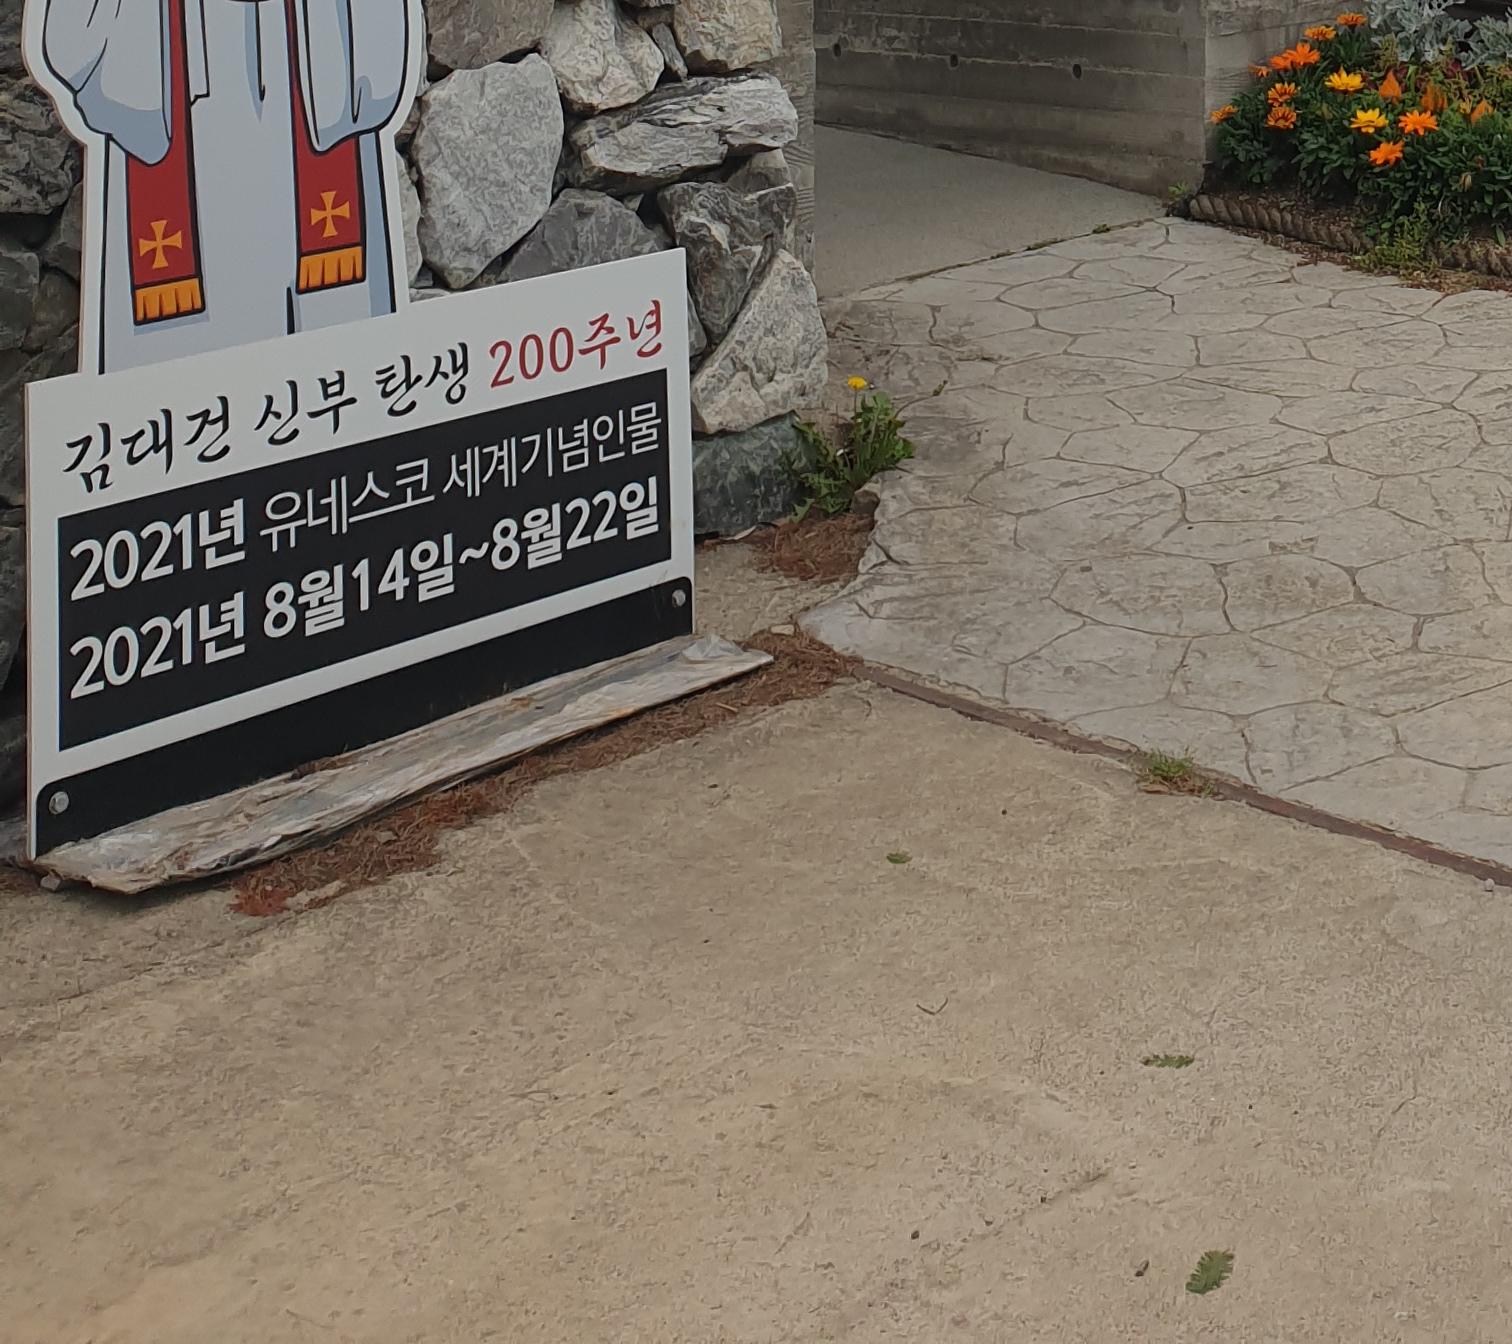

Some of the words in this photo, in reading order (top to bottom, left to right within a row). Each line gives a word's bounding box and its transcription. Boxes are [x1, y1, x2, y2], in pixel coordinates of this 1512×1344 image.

[64, 396, 232, 494] 김대건
[254, 369, 359, 443] 신부
[375, 341, 472, 417] 탄생
[489, 300, 664, 389] 200주년
[69, 498, 246, 601] 2021년
[259, 457, 436, 553] 유네스코
[442, 401, 662, 496] 세계기념인물
[69, 591, 246, 700] 2021년
